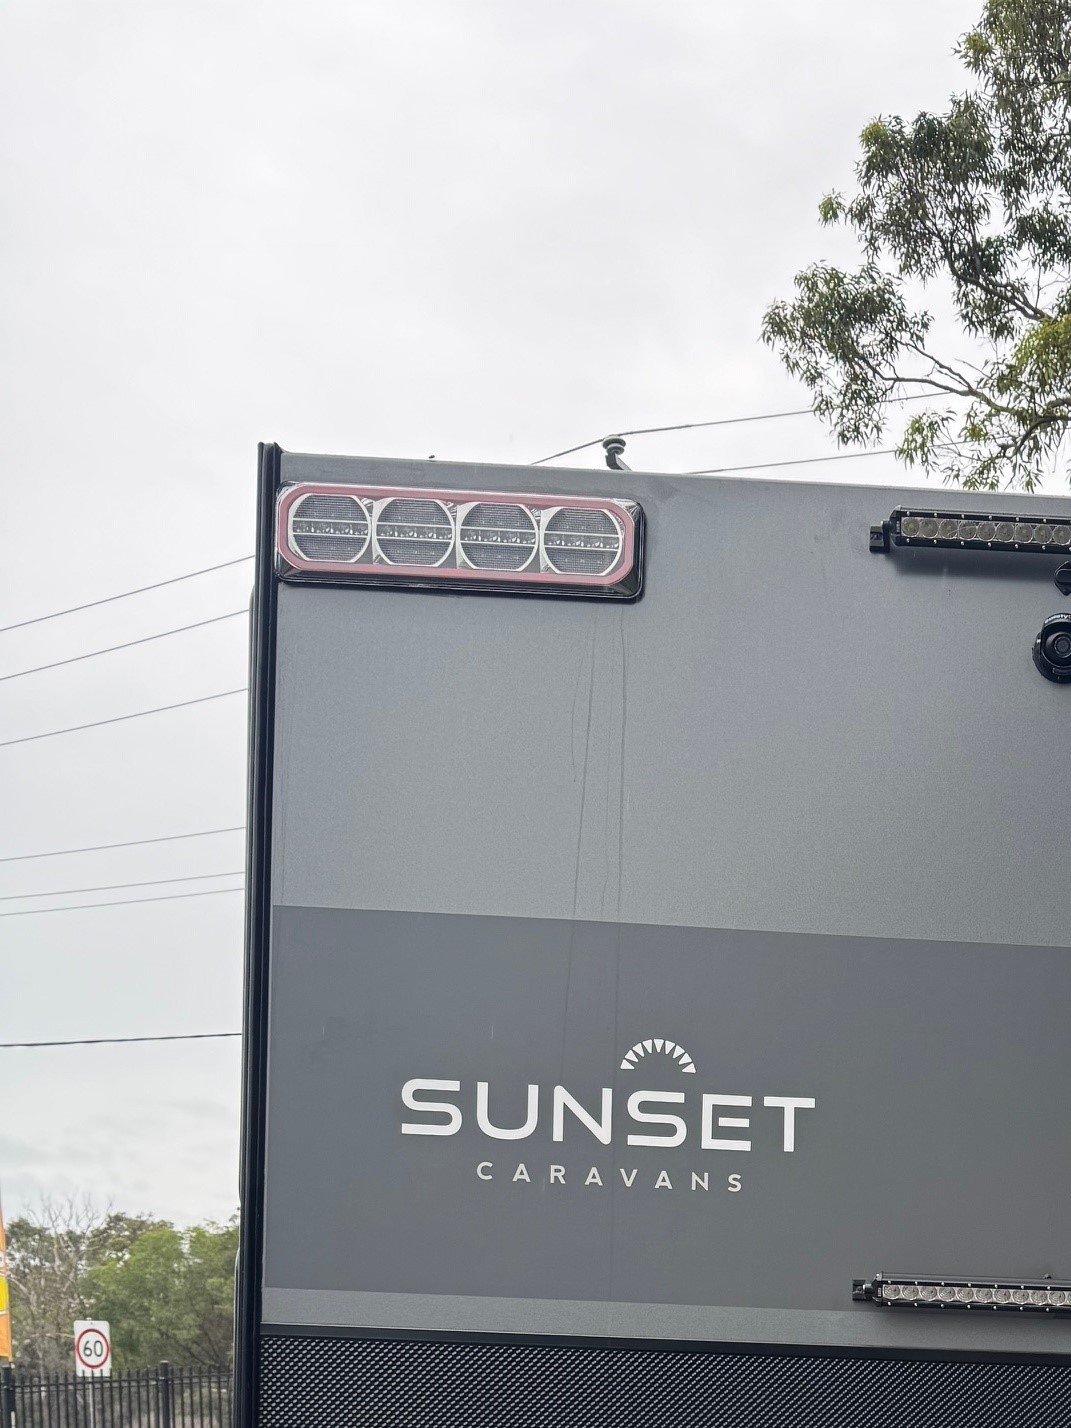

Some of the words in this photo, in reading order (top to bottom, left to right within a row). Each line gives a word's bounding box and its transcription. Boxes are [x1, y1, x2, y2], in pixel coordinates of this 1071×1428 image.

[401, 1078, 816, 1153] SUNSET
[476, 1161, 742, 1193] CARAVANS
[83, 1340, 104, 1357] 60
